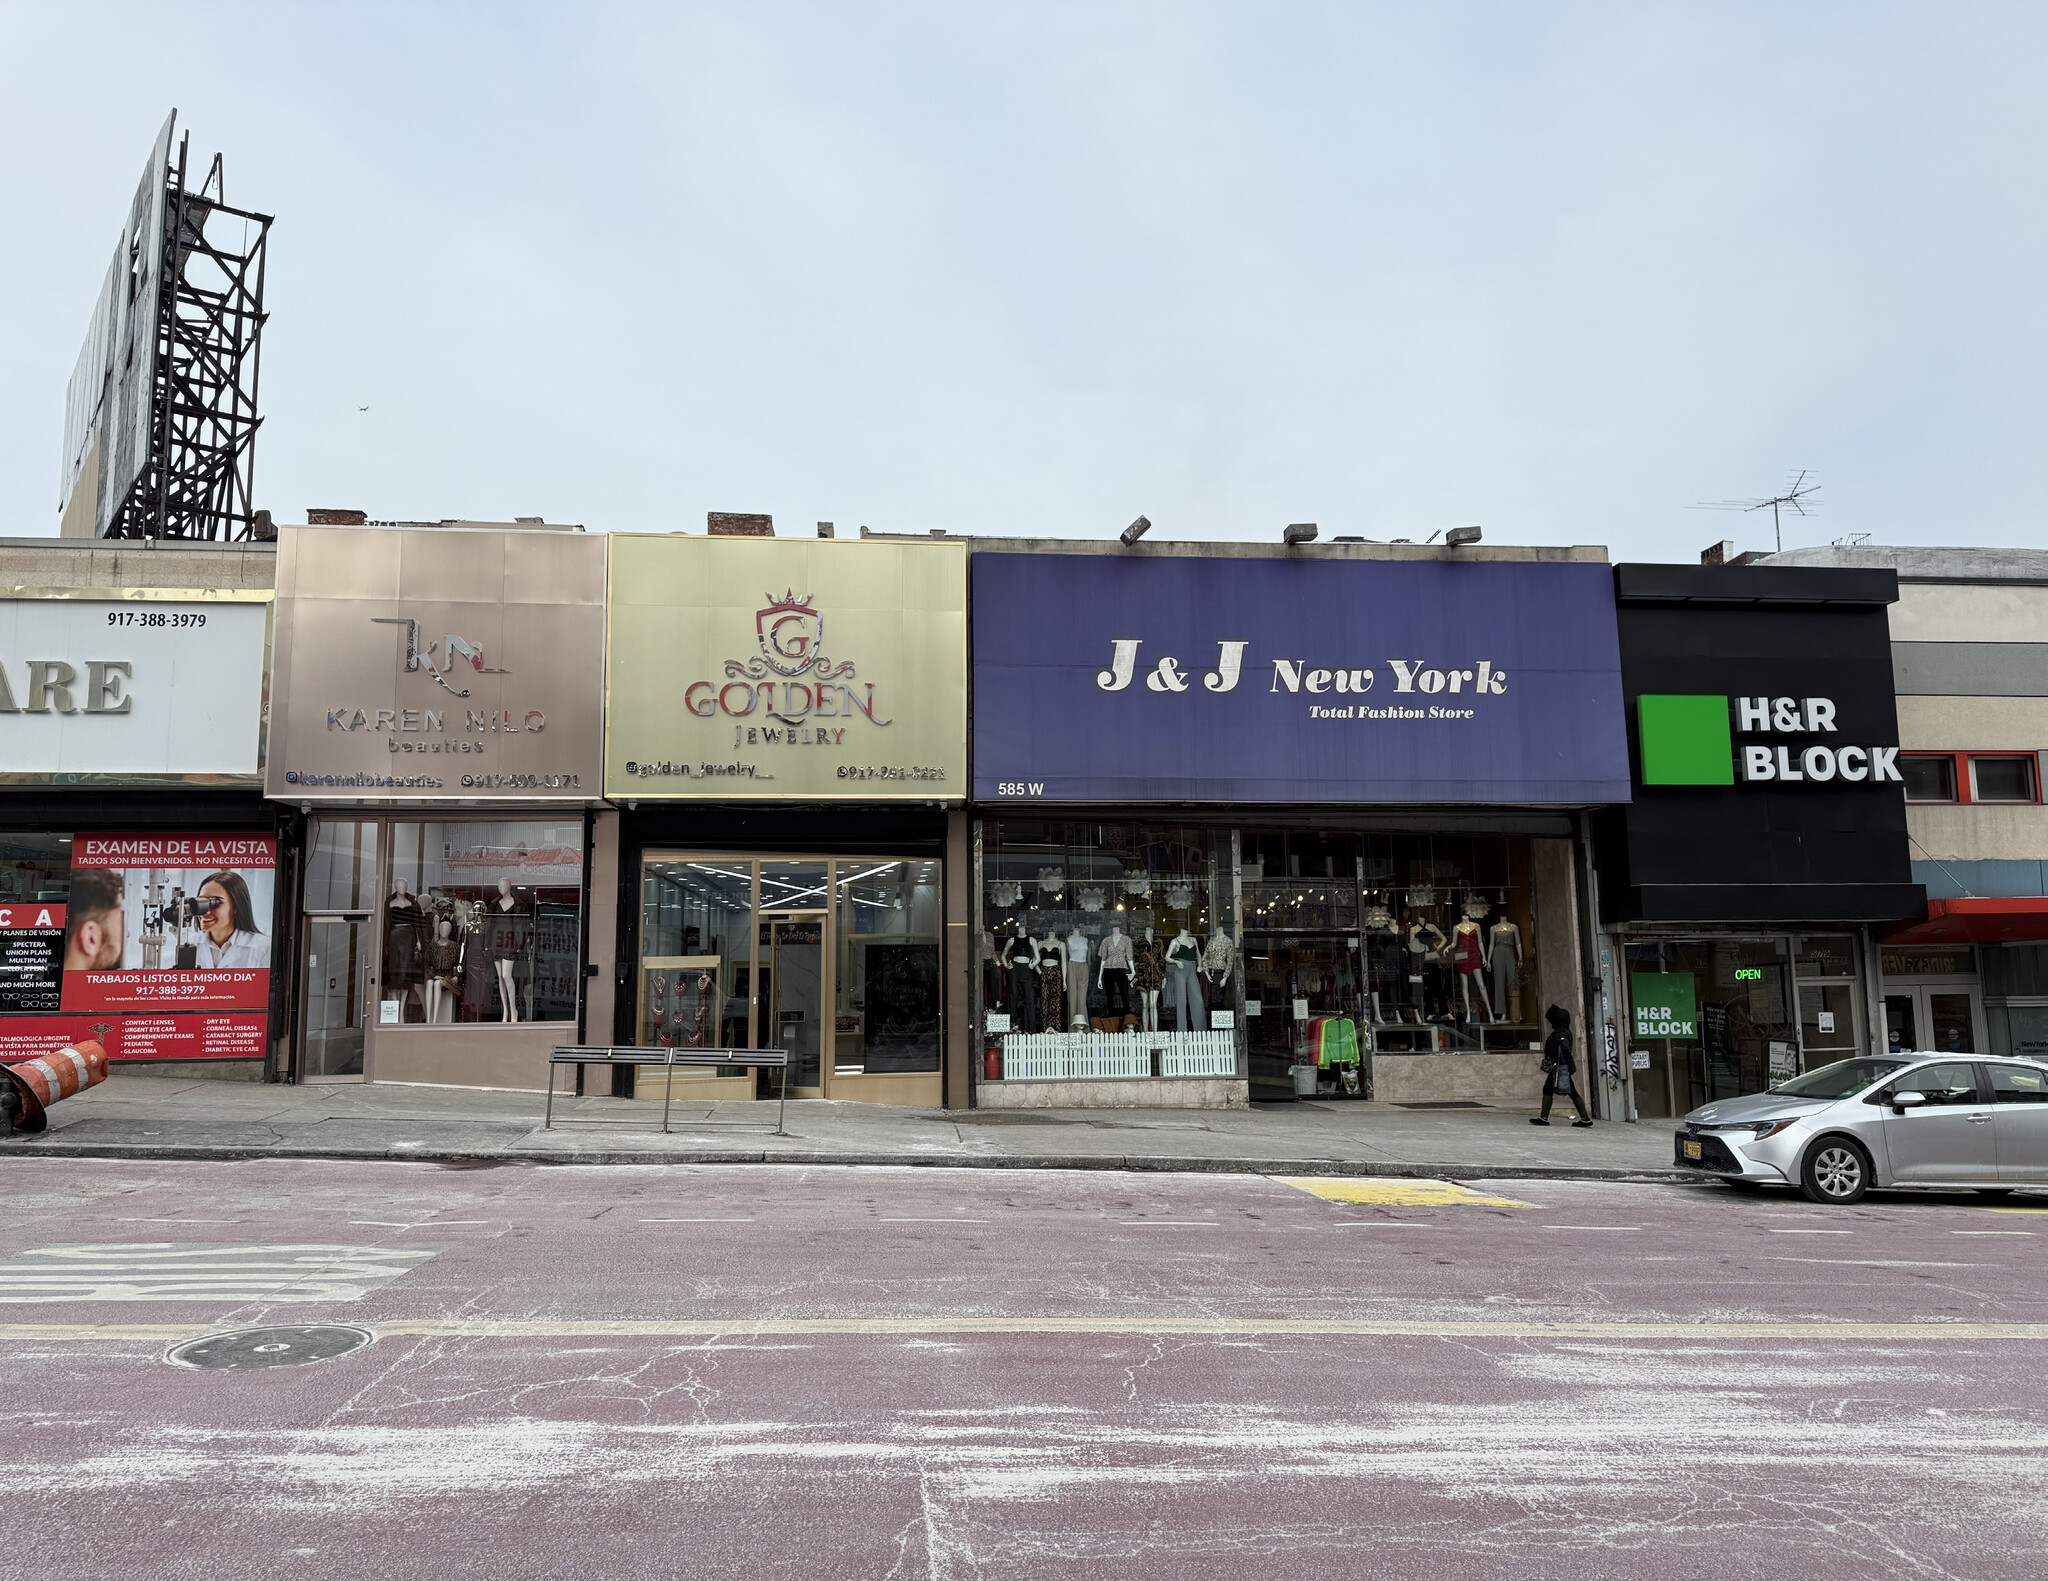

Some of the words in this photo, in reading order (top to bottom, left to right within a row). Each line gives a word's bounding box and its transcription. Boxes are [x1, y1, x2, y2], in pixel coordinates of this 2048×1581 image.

[108, 612, 207, 627] 917-388-3979
[1098, 639, 1143, 692] J
[1146, 656, 1190, 693] &
[1203, 641, 1249, 693] J
[1270, 659, 1374, 694] New
[1386, 660, 1508, 695] York
[684, 681, 892, 726] GOLDEN
[1309, 705, 1354, 719] Total
[1357, 705, 1425, 719] Fashion
[1428, 706, 1474, 719] Store
[1735, 697, 1838, 732] H&R
[326, 708, 445, 732] KAREN
[466, 709, 546, 733] NILO
[733, 725, 846, 749] JEWELRY
[388, 739, 484, 753] beauties
[1743, 746, 1904, 782] BLOCK
[998, 783, 1026, 796] 585
[1028, 783, 1044, 796] W
[87, 841, 164, 854] EXAMEN
[167, 841, 191, 854] DE
[196, 841, 216, 854] LA
[220, 841, 269, 854] VISTA
[110, 857, 130, 865] SON
[131, 857, 194, 865] BIENVENIDOS.
[1905, 957, 1929, 968] 575
[86, 974, 141, 983] TRABAJOS
[143, 974, 178, 983] LISTOS
[180, 974, 191, 983] EL
[194, 973, 232, 982] MISMO
[1735, 969, 1762, 980] OPEN
[136, 986, 205, 994] 917-388-3979
[1636, 1006, 1672, 1020] H&R
[1638, 1021, 1693, 1035] BLOCK
